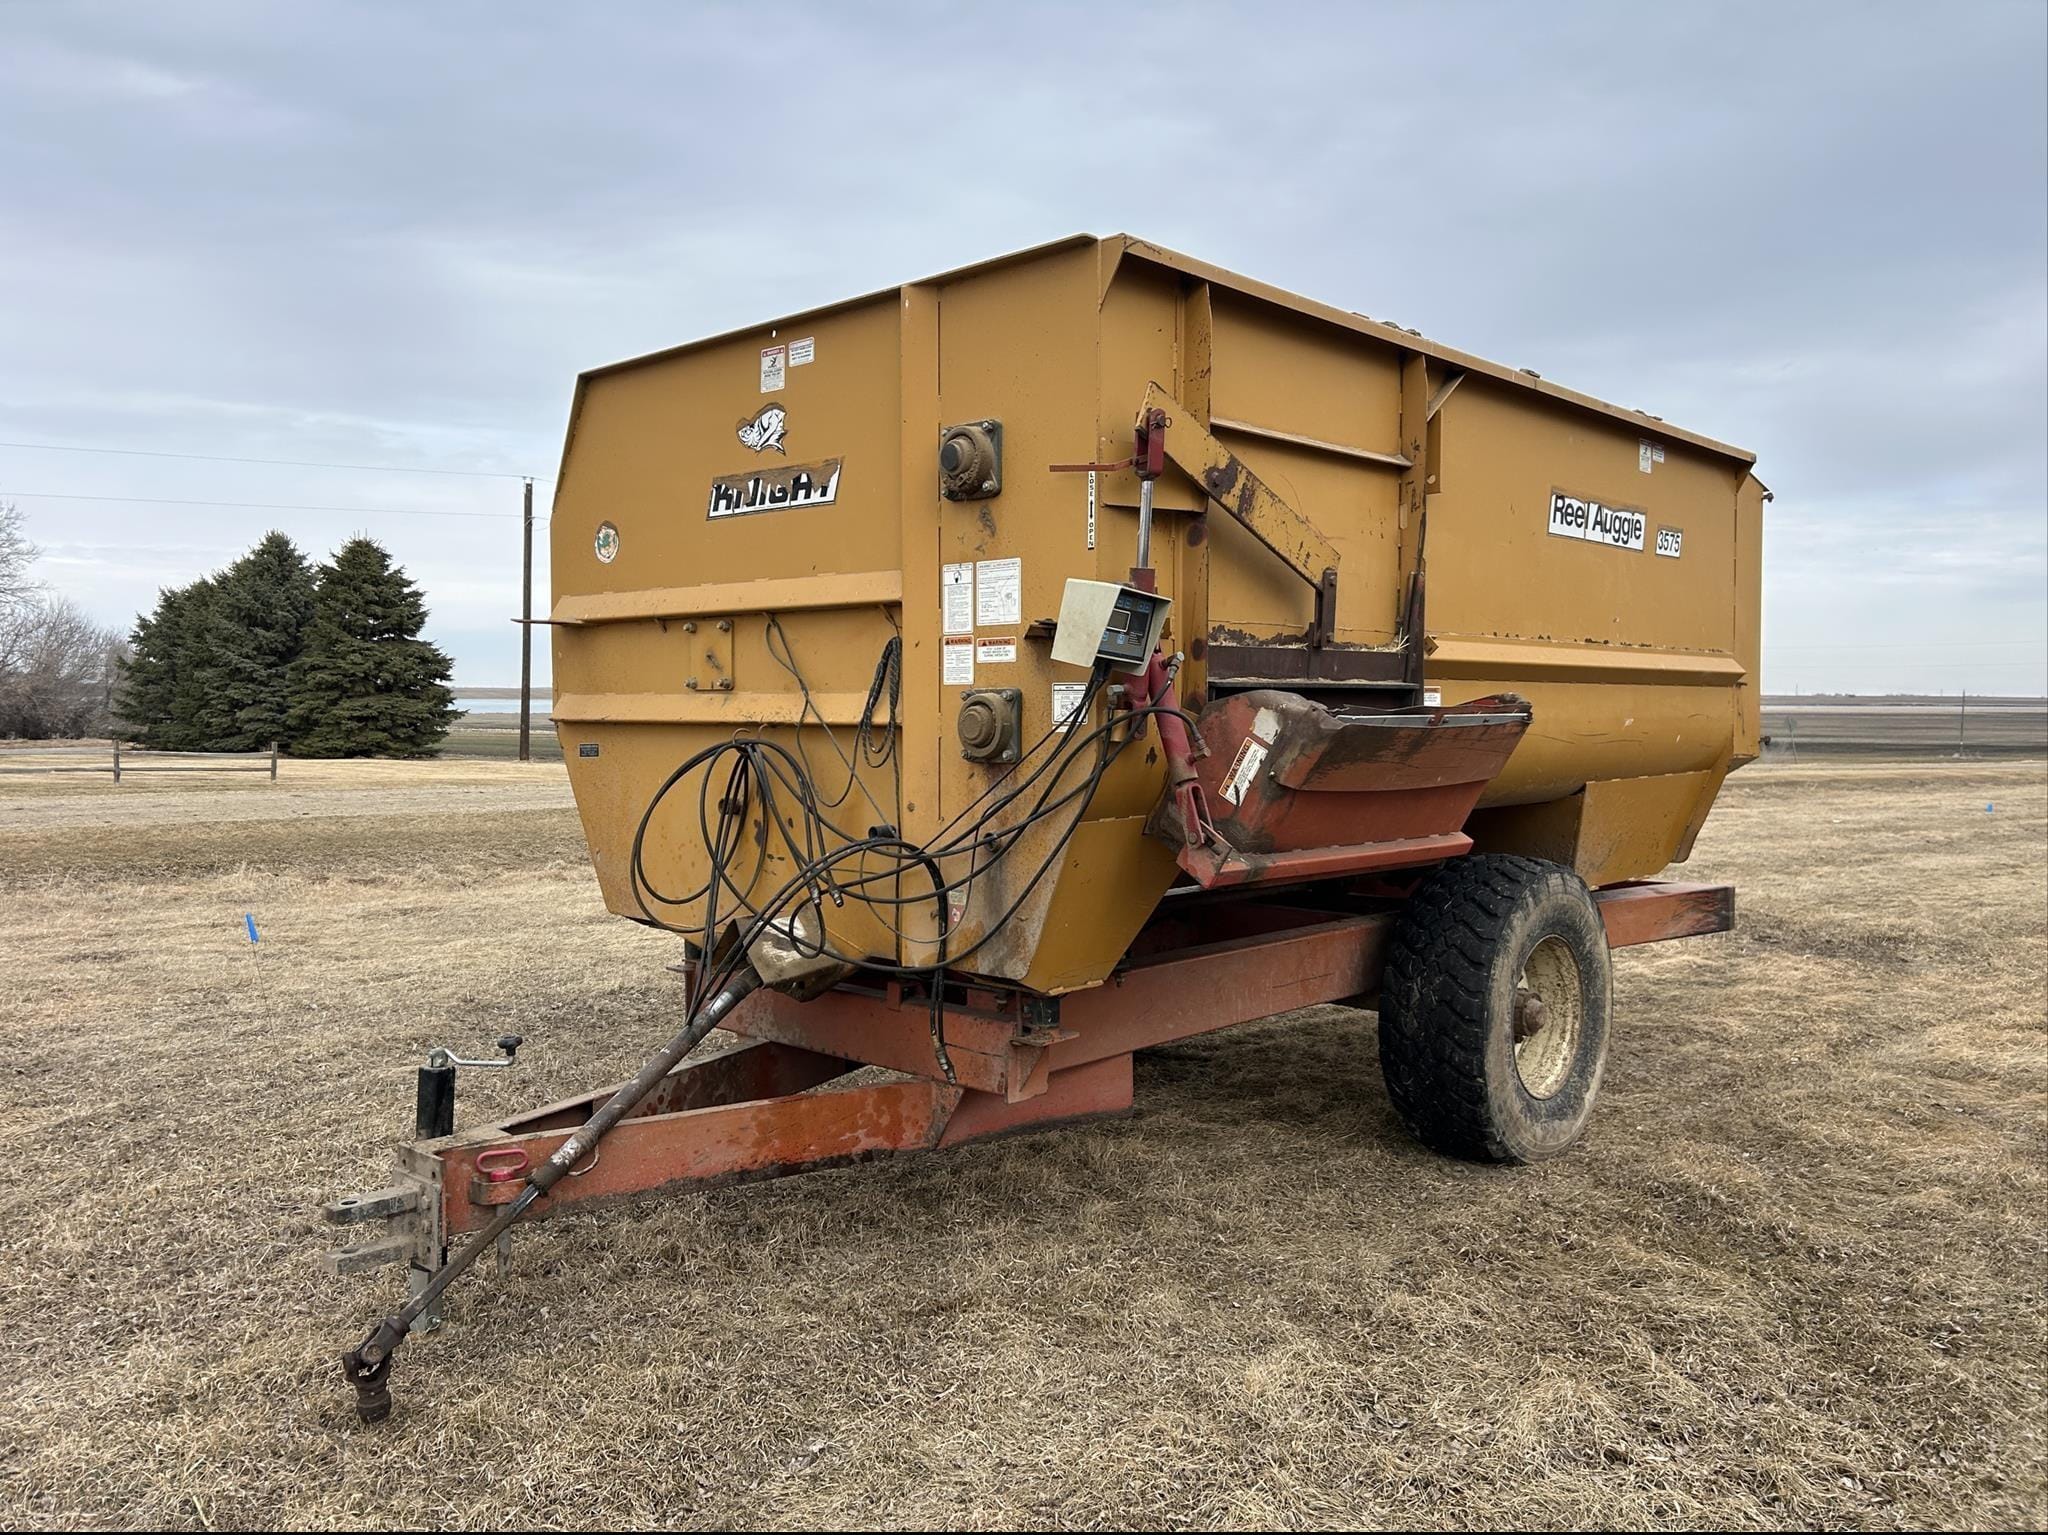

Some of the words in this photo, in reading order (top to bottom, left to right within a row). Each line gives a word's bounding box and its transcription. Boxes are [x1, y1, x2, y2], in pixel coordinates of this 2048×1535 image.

[712, 472, 829, 513] KNGH
[1552, 494, 1591, 530] Reel
[1592, 505, 1642, 545] Auggie
[1657, 531, 1680, 553] 3575
